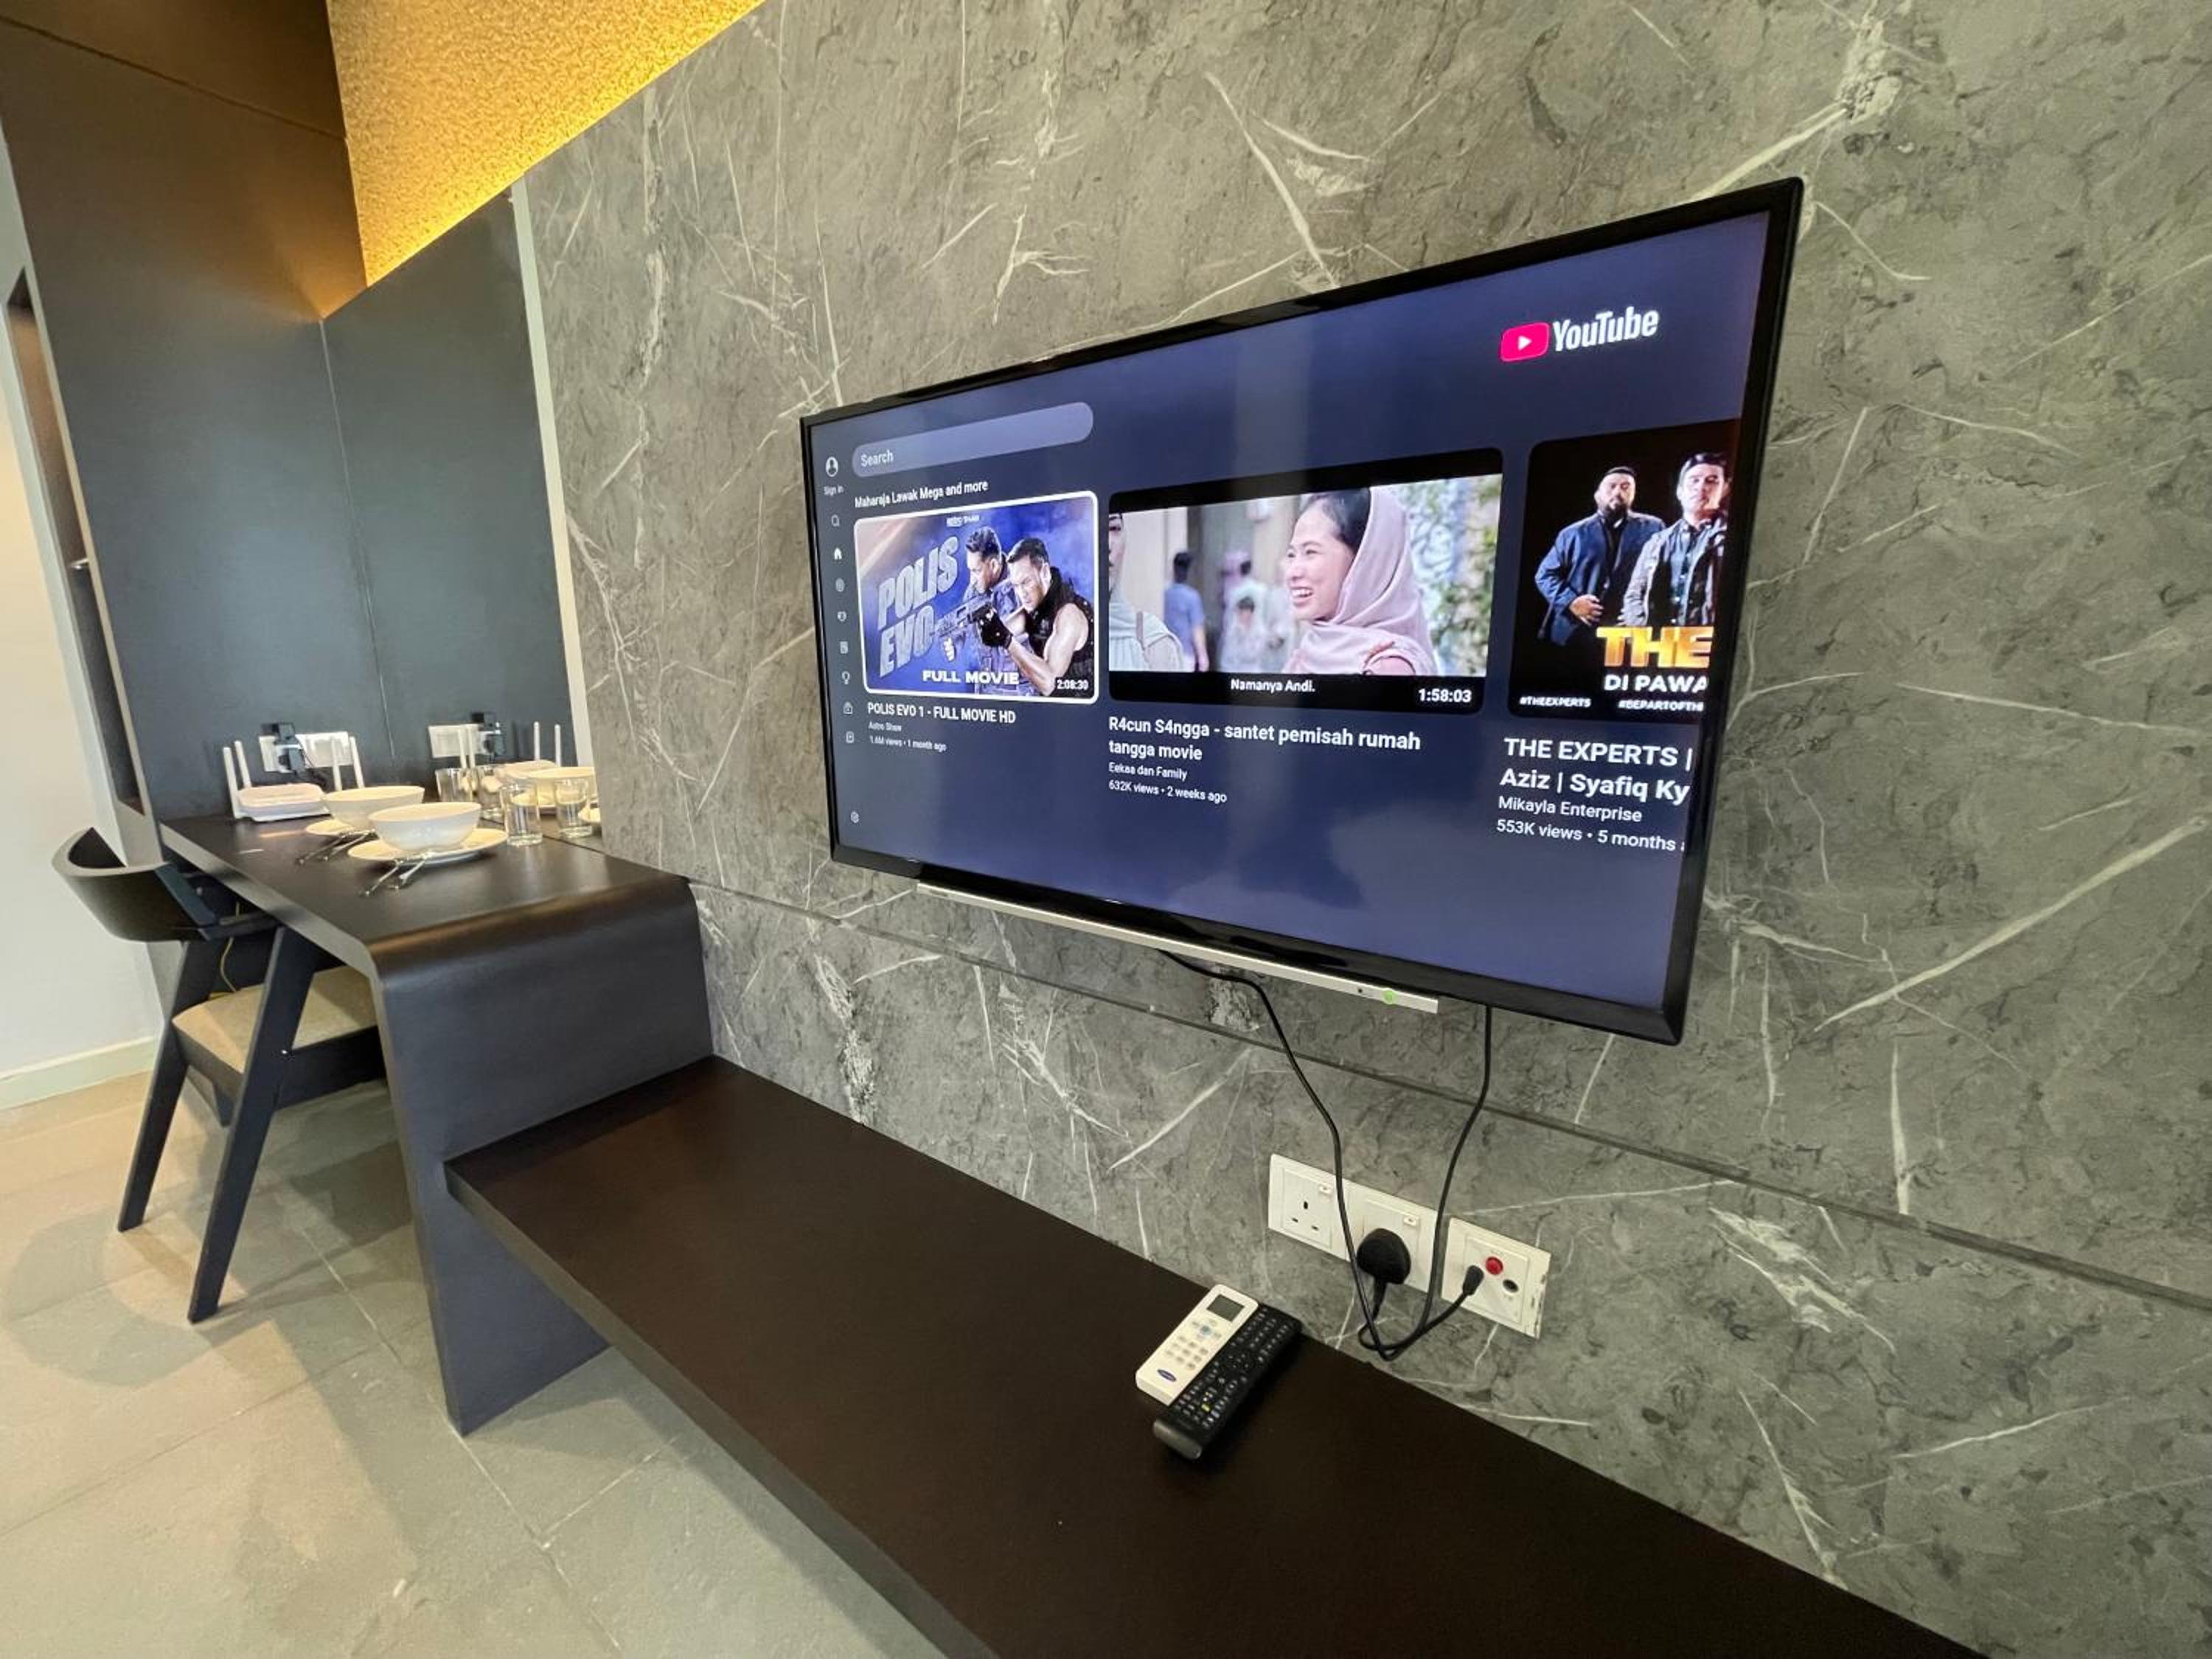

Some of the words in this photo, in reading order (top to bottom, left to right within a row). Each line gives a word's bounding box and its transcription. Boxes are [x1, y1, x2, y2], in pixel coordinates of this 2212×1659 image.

[1552, 306, 1659, 352] YouTube
[860, 450, 894, 467] Search
[855, 494, 890, 508] Maharaja
[891, 490, 918, 503] Lawak
[920, 487, 944, 501] Mega
[945, 481, 961, 495] and
[964, 480, 989, 493] more
[877, 536, 958, 630] POLIS
[880, 605, 934, 678] EVO
[1596, 626, 1714, 668] THE
[922, 669, 961, 683] FULL
[965, 671, 1020, 685] MOVIE
[1057, 678, 1089, 691] 2:08:30
[1231, 678, 1283, 694] Namanya
[1284, 680, 1316, 692] Andi.
[1604, 674, 1629, 691] DI
[1418, 688, 1472, 703] 1:58:03
[1520, 695, 1591, 708] #THEEXPERTS
[867, 702, 895, 715] POLIS
[897, 703, 917, 717] EVO
[918, 706, 925, 717] 1
[933, 706, 959, 720] FULL
[961, 707, 997, 722] MOVIE
[998, 710, 1017, 723] HD
[1109, 716, 1152, 733] R4cun
[1155, 718, 1210, 740] S4ngga
[1224, 725, 1275, 741] santet
[1278, 727, 1354, 746] pemisah
[1358, 731, 1421, 750] rumah
[886, 737, 902, 748] views
[912, 740, 933, 750] month
[933, 742, 947, 753] ago
[1109, 740, 1155, 759] tangga
[1158, 744, 1203, 760] movie
[1503, 737, 1553, 759] THE
[1558, 740, 1679, 767] EXPERTS
[1137, 764, 1155, 776] dan
[1156, 765, 1188, 782] Family
[1108, 779, 1133, 792] 632K
[1133, 782, 1159, 796] views
[1167, 786, 1173, 797] 2
[1175, 788, 1206, 801] weeks
[1208, 791, 1228, 804] ago
[1500, 768, 1551, 790] Aziz
[1569, 773, 1649, 802] Syafiq
[1655, 779, 1691, 806] Ky
[1498, 796, 1556, 816] Mikayla
[1561, 801, 1643, 823] Enterprise
[1497, 818, 1535, 836] 553K
[1539, 823, 1583, 841] views
[1597, 829, 1608, 844] 5
[1611, 832, 1677, 852] months
